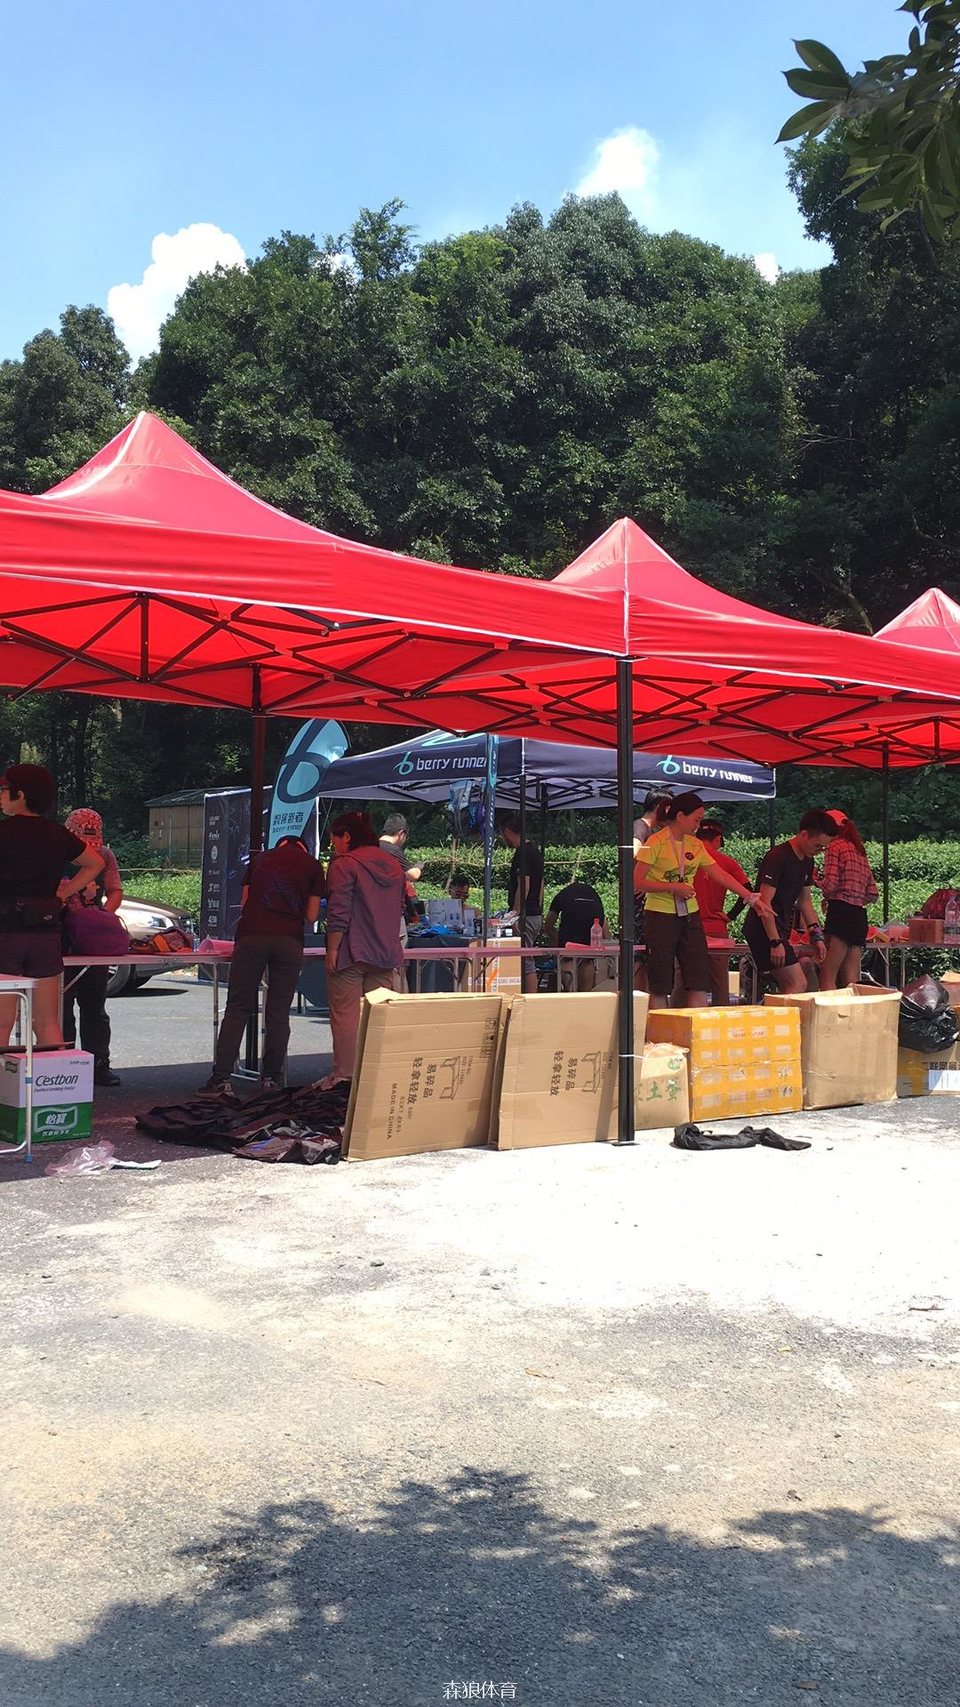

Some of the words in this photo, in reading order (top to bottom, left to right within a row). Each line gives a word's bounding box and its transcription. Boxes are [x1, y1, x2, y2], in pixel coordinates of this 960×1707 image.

[417, 757, 450, 771] berry
[683, 761, 717, 778] berry
[719, 770, 754, 784] runner
[407, 1057, 423, 1105] 轻拿轻放
[423, 1064, 437, 1098] 易碎品
[550, 1050, 564, 1096] 轻拿轻放
[565, 1058, 578, 1091] 易碎品
[389, 1083, 397, 1105] MADE
[389, 1106, 395, 1115] IN
[387, 1115, 395, 1140] CHINA
